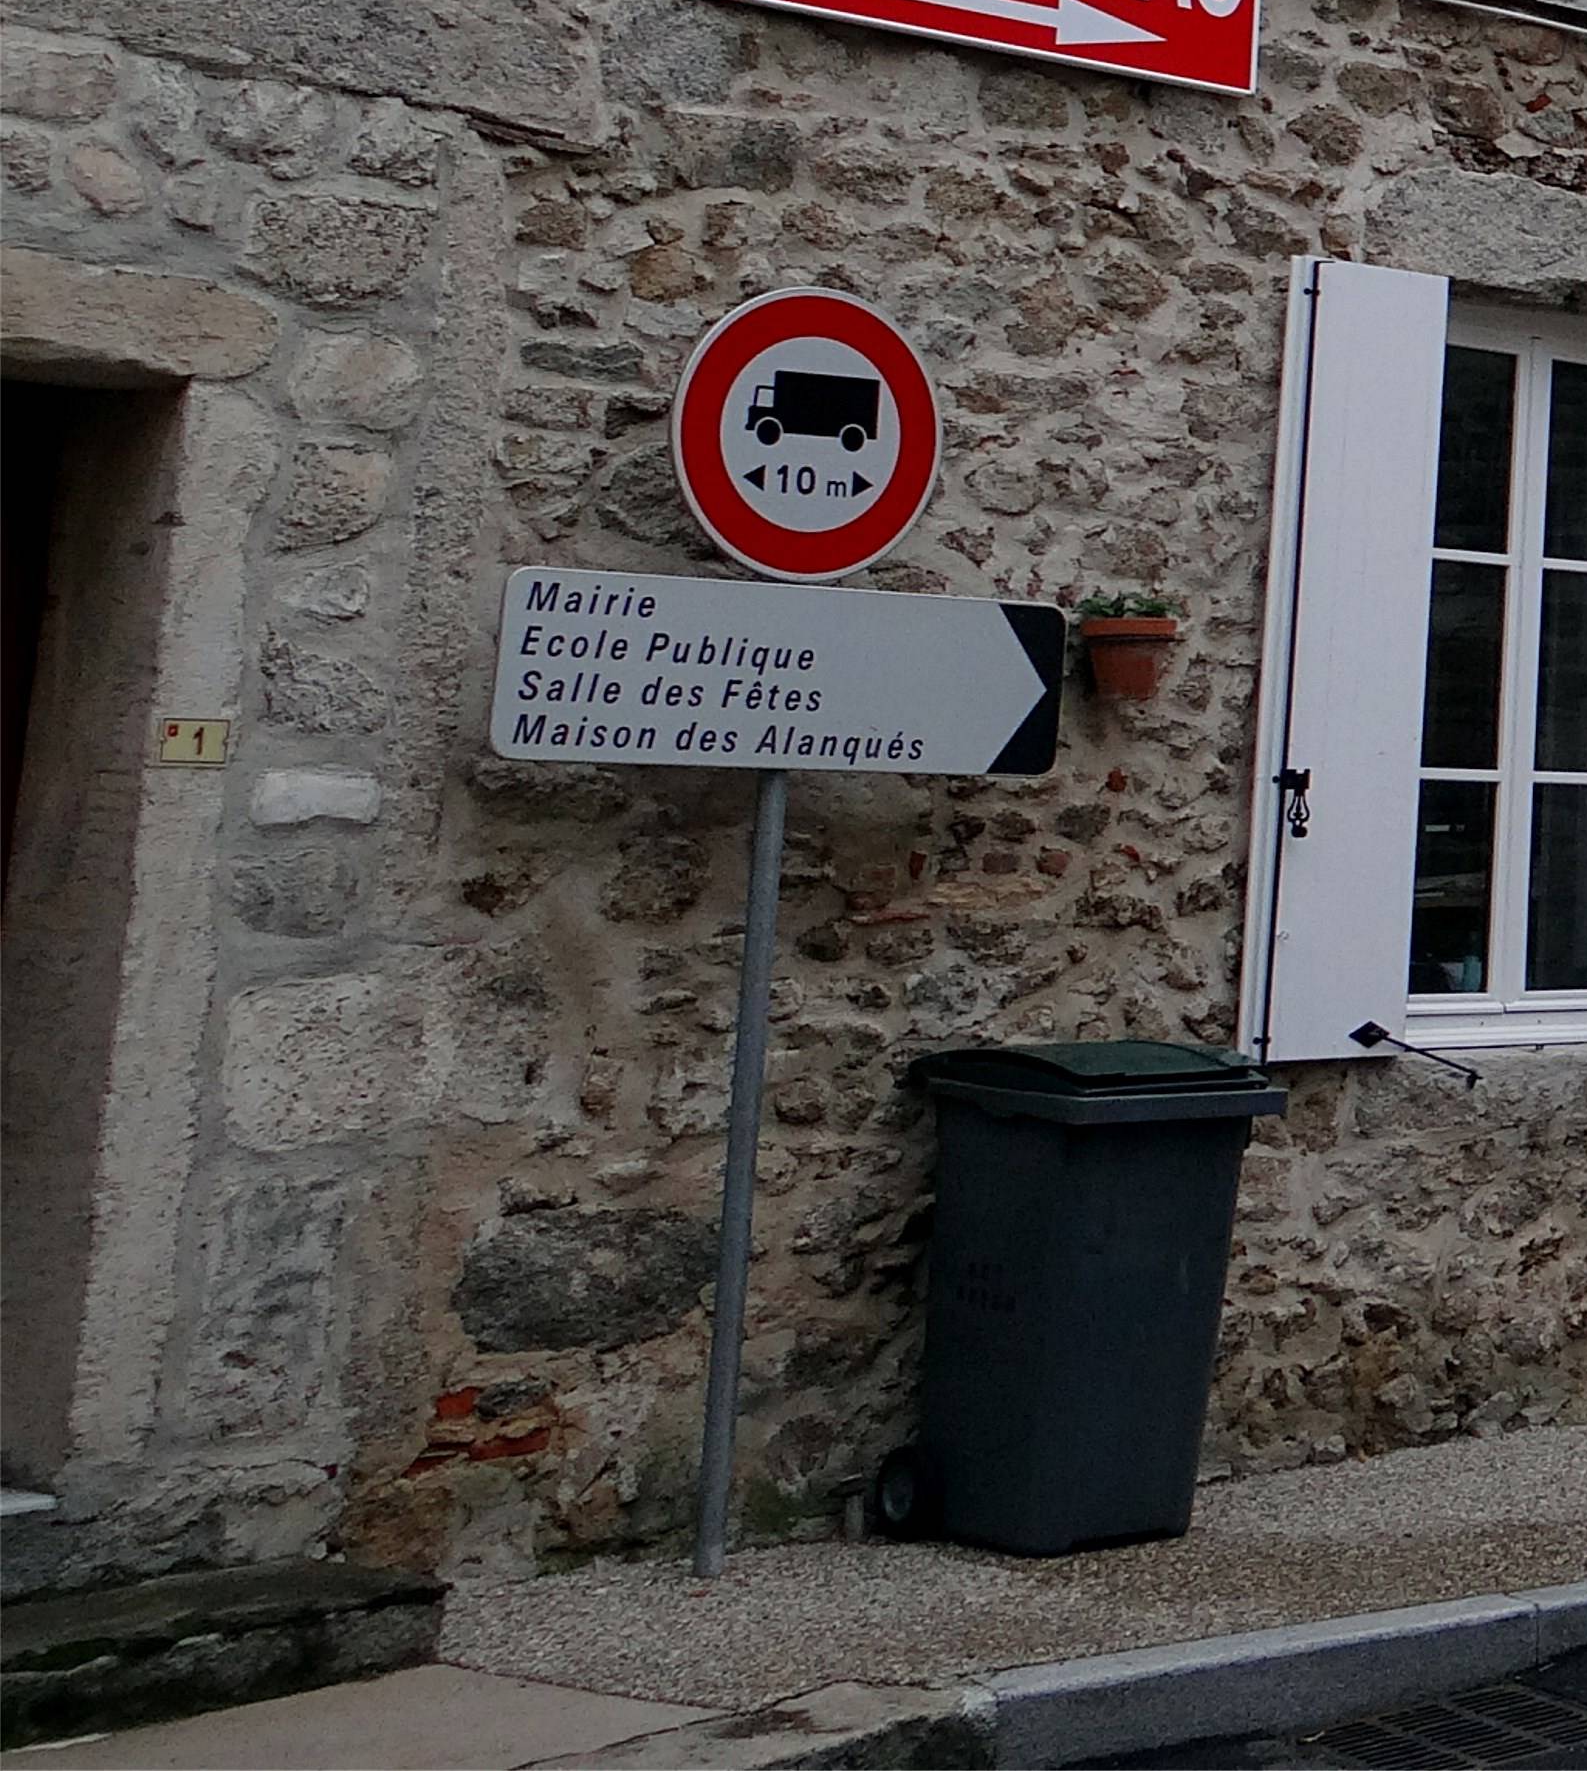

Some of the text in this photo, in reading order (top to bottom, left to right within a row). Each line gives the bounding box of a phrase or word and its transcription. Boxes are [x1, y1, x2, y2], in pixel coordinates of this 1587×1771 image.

[777, 464, 847, 498] 10 m
[526, 581, 657, 618] Mairie
[520, 626, 815, 676] Ecole Publique
[518, 670, 822, 712] Salle des Fêtes
[193, 726, 205, 756] 1
[512, 714, 925, 766] Maison des Alanqués
